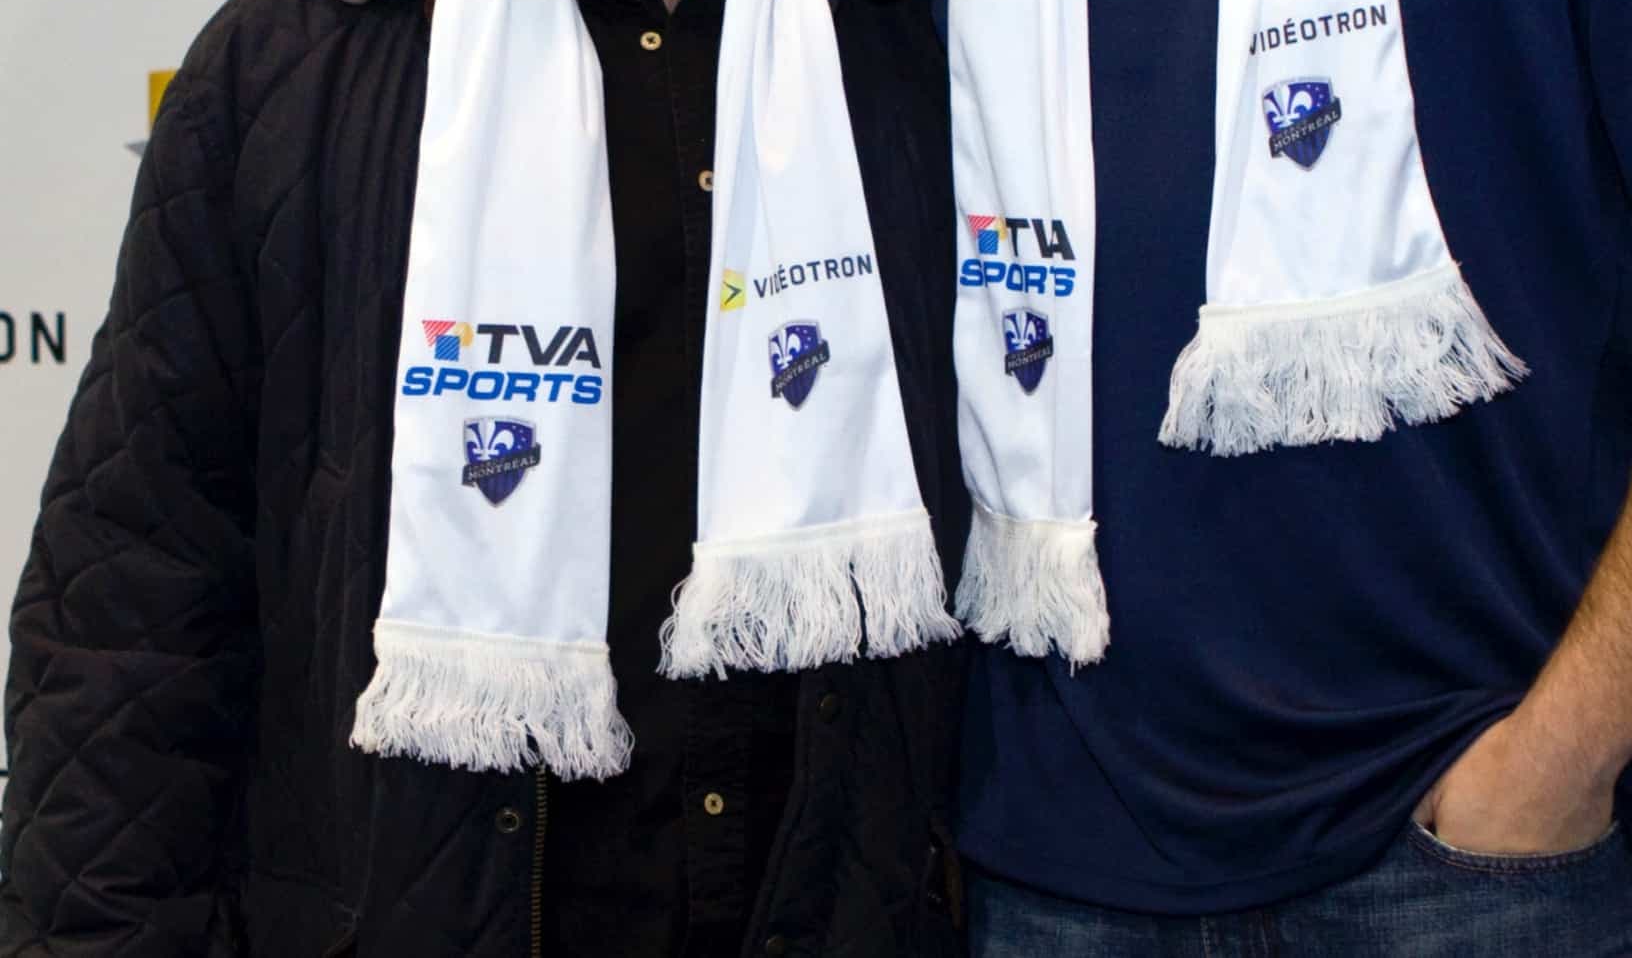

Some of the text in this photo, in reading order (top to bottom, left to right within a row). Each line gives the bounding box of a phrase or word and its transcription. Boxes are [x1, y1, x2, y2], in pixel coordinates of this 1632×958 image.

[1005, 217, 1076, 261] TVA
[476, 323, 602, 370] TVA
[402, 366, 603, 405] SPORTS
